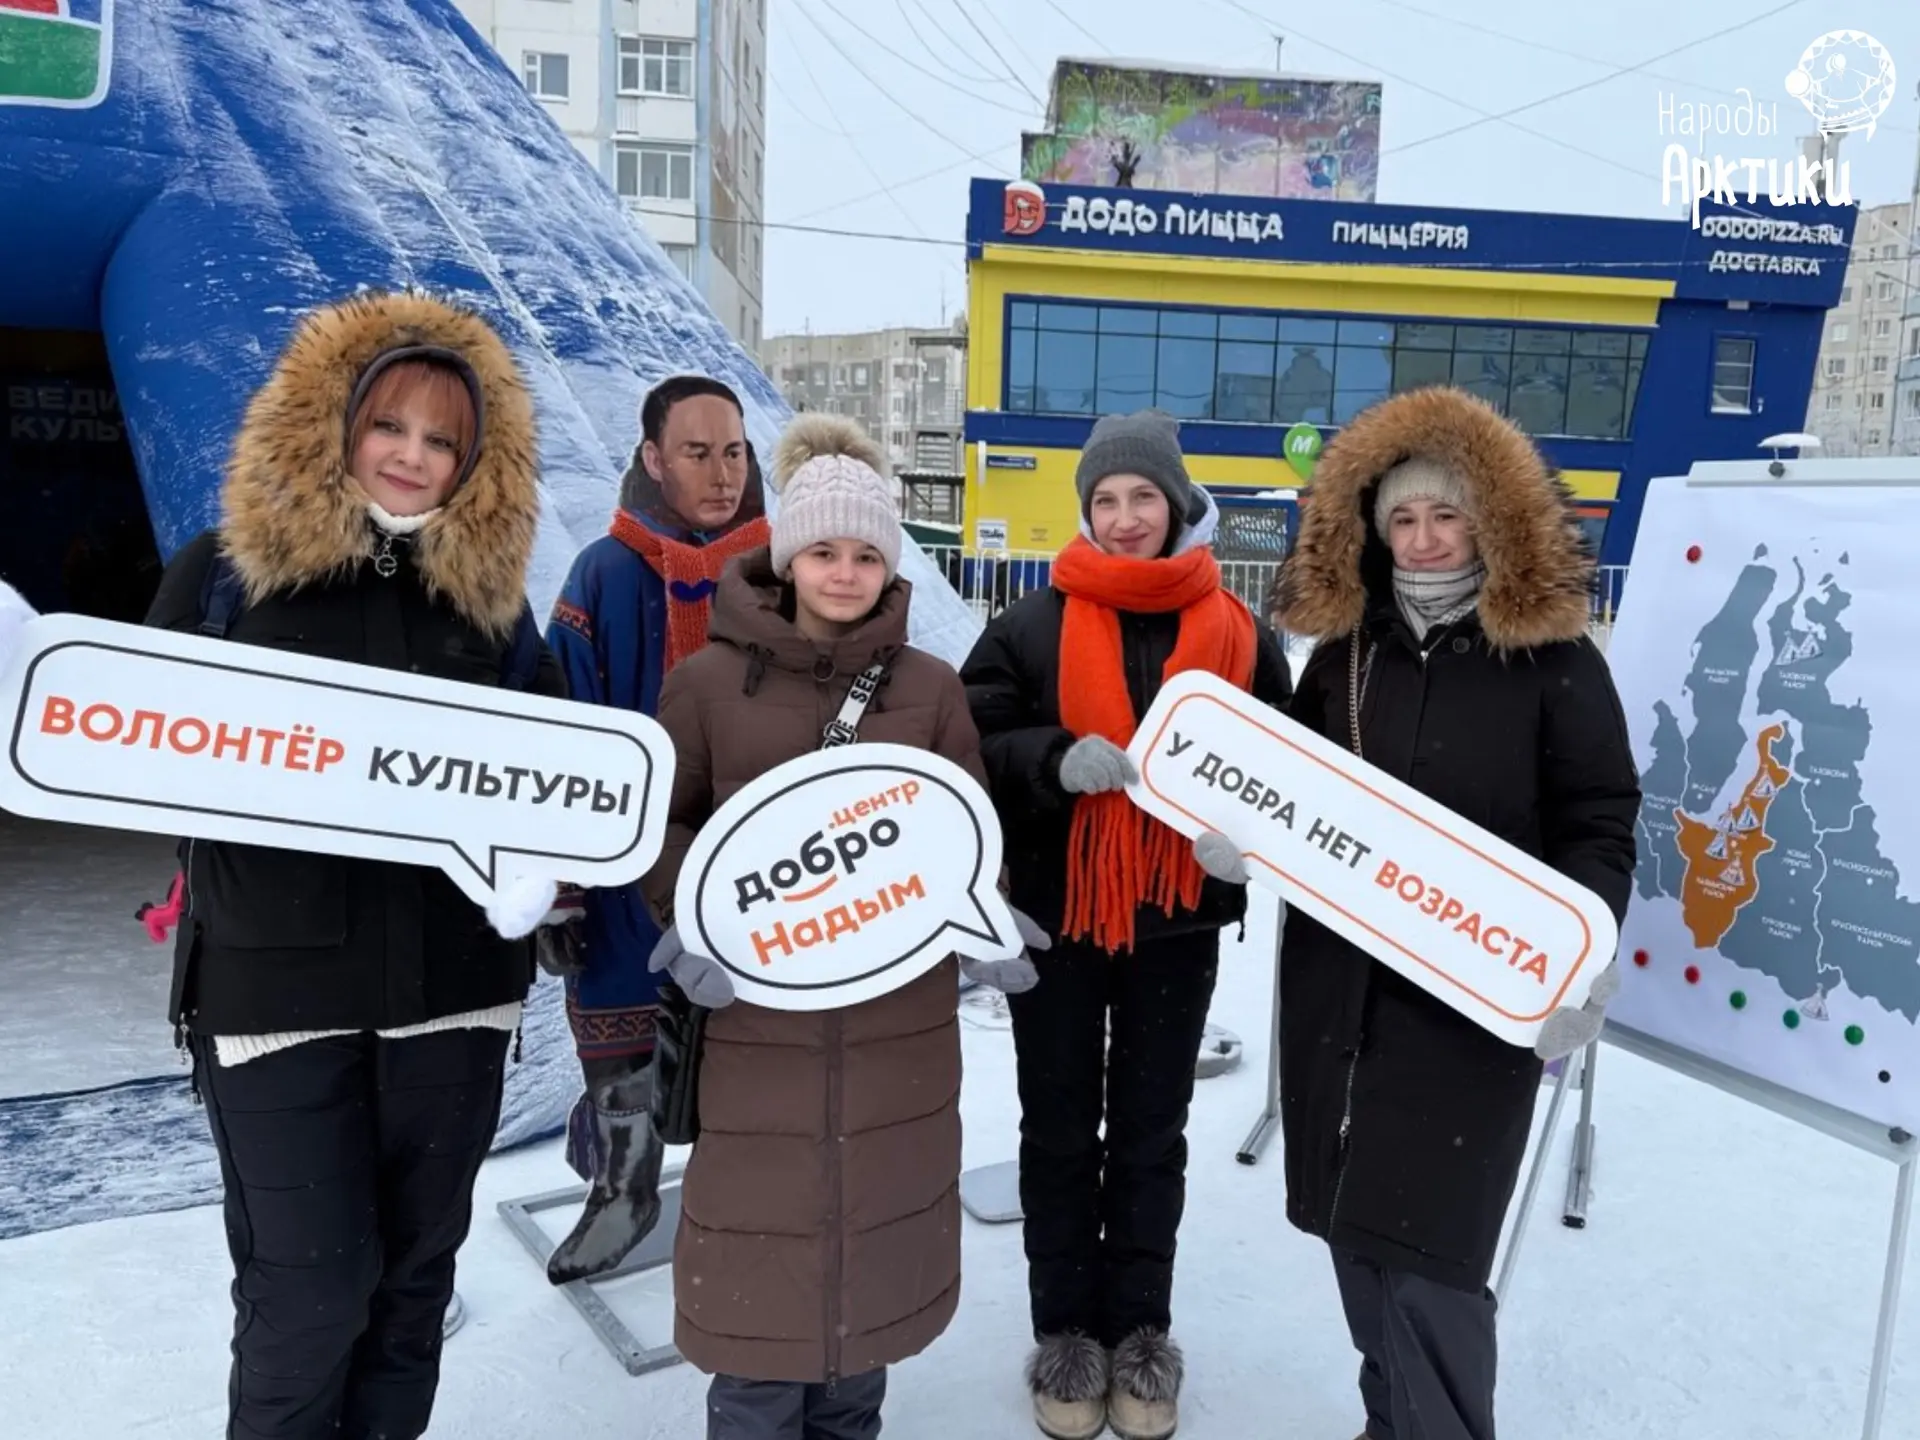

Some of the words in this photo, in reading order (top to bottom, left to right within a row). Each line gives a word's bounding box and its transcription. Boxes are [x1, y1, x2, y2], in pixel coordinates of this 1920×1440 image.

[1061, 196, 1157, 237] ДОДО
[1165, 204, 1283, 243] ПИЦЦА
[1332, 221, 1469, 250] ПИЦЦЕРИЯ
[1701, 215, 1844, 246] DODOPIZZA.RU
[1709, 250, 1821, 276] ДОСТАВКА
[10, 415, 124, 442] КУЛЬ
[40, 695, 345, 774] ВОЛОНТЁР
[368, 746, 632, 816] КУЛЬТУРЫ
[734, 818, 901, 914] добро
[1166, 732, 1194, 758] У
[1192, 752, 1296, 830] ДОБРА
[1306, 817, 1372, 869] НЕТ
[1374, 860, 1549, 985] ВОЗРАСТА
[750, 874, 926, 966] Надым
